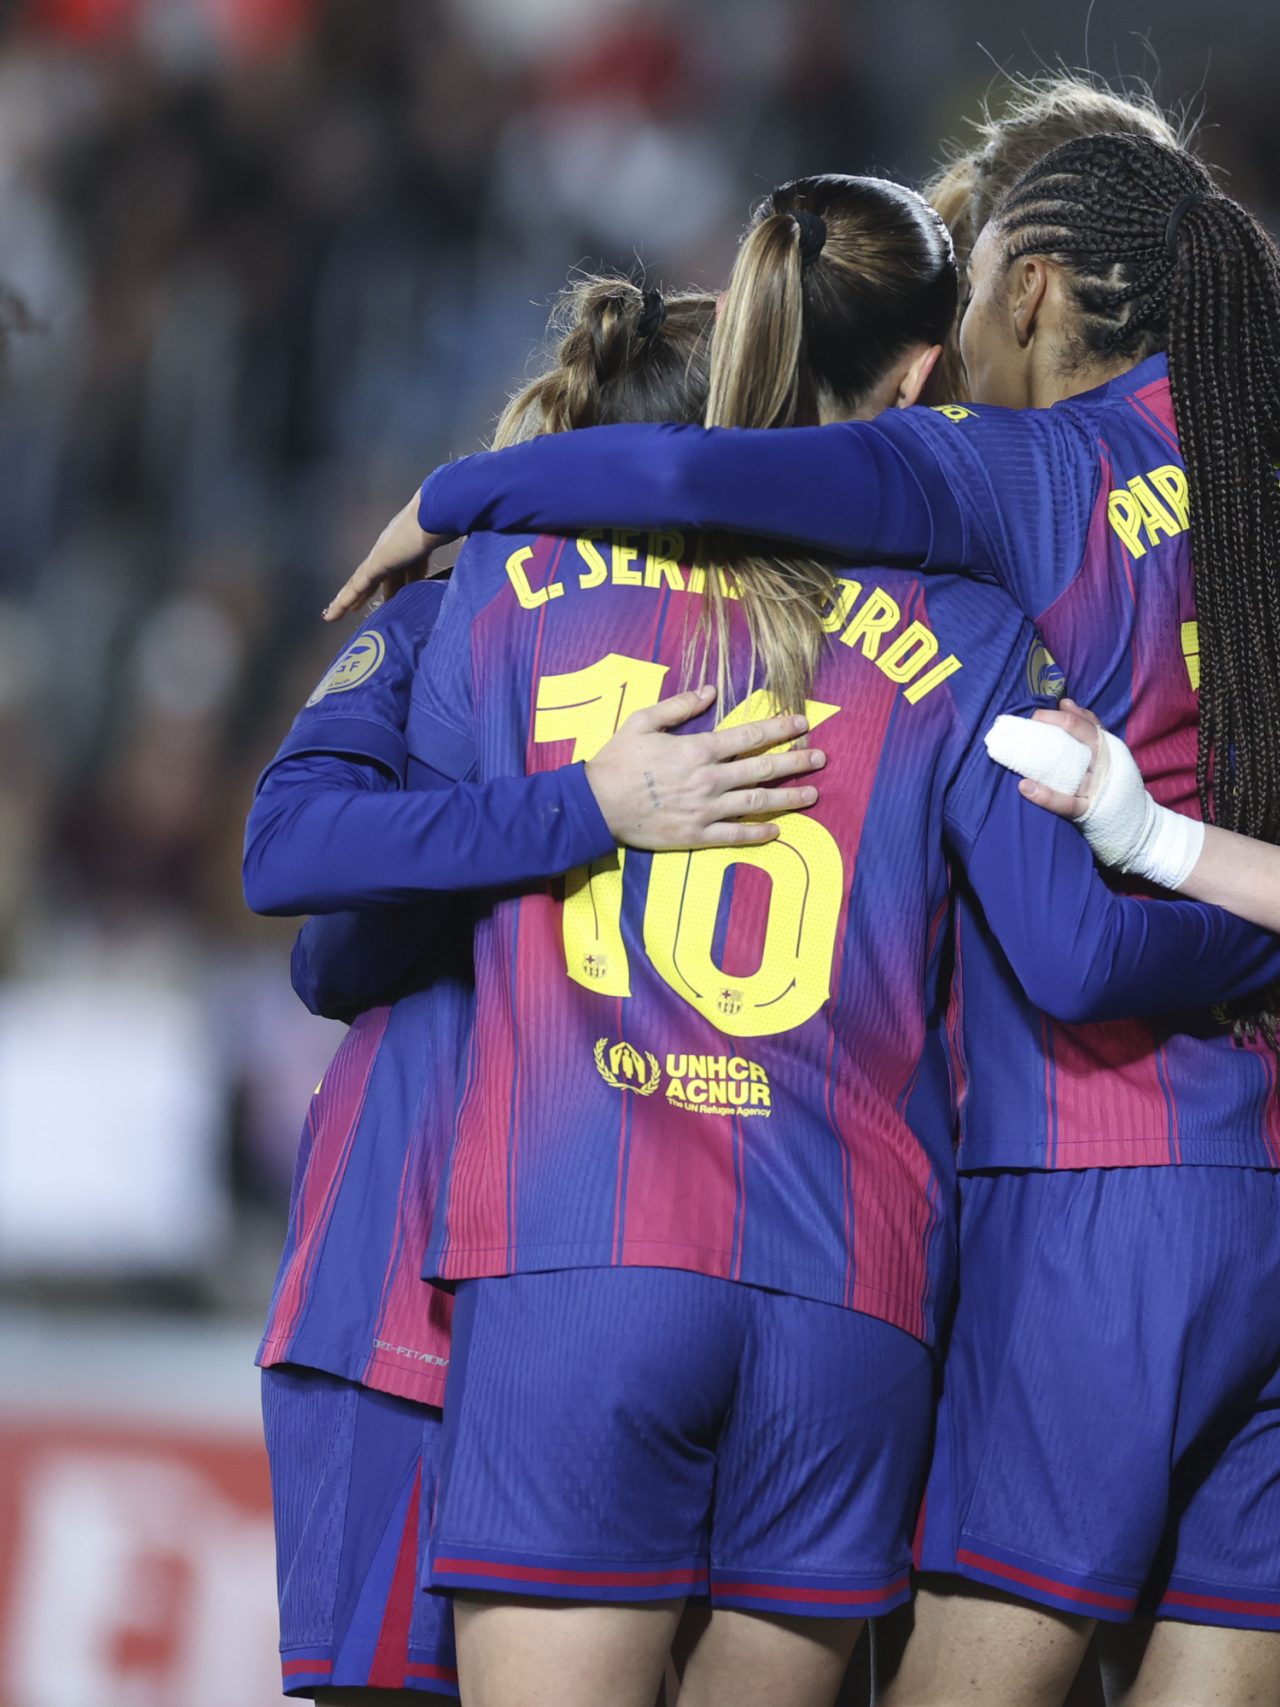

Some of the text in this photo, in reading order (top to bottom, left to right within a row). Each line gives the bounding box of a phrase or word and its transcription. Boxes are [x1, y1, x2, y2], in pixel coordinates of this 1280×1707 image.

[505, 546, 564, 609] C.
[534, 653, 844, 1037] 16
[665, 1054, 769, 1084] UNHCR
[665, 1078, 771, 1106] ACNUR
[684, 1103, 698, 1112] UN
[736, 1106, 771, 1118] Agency
